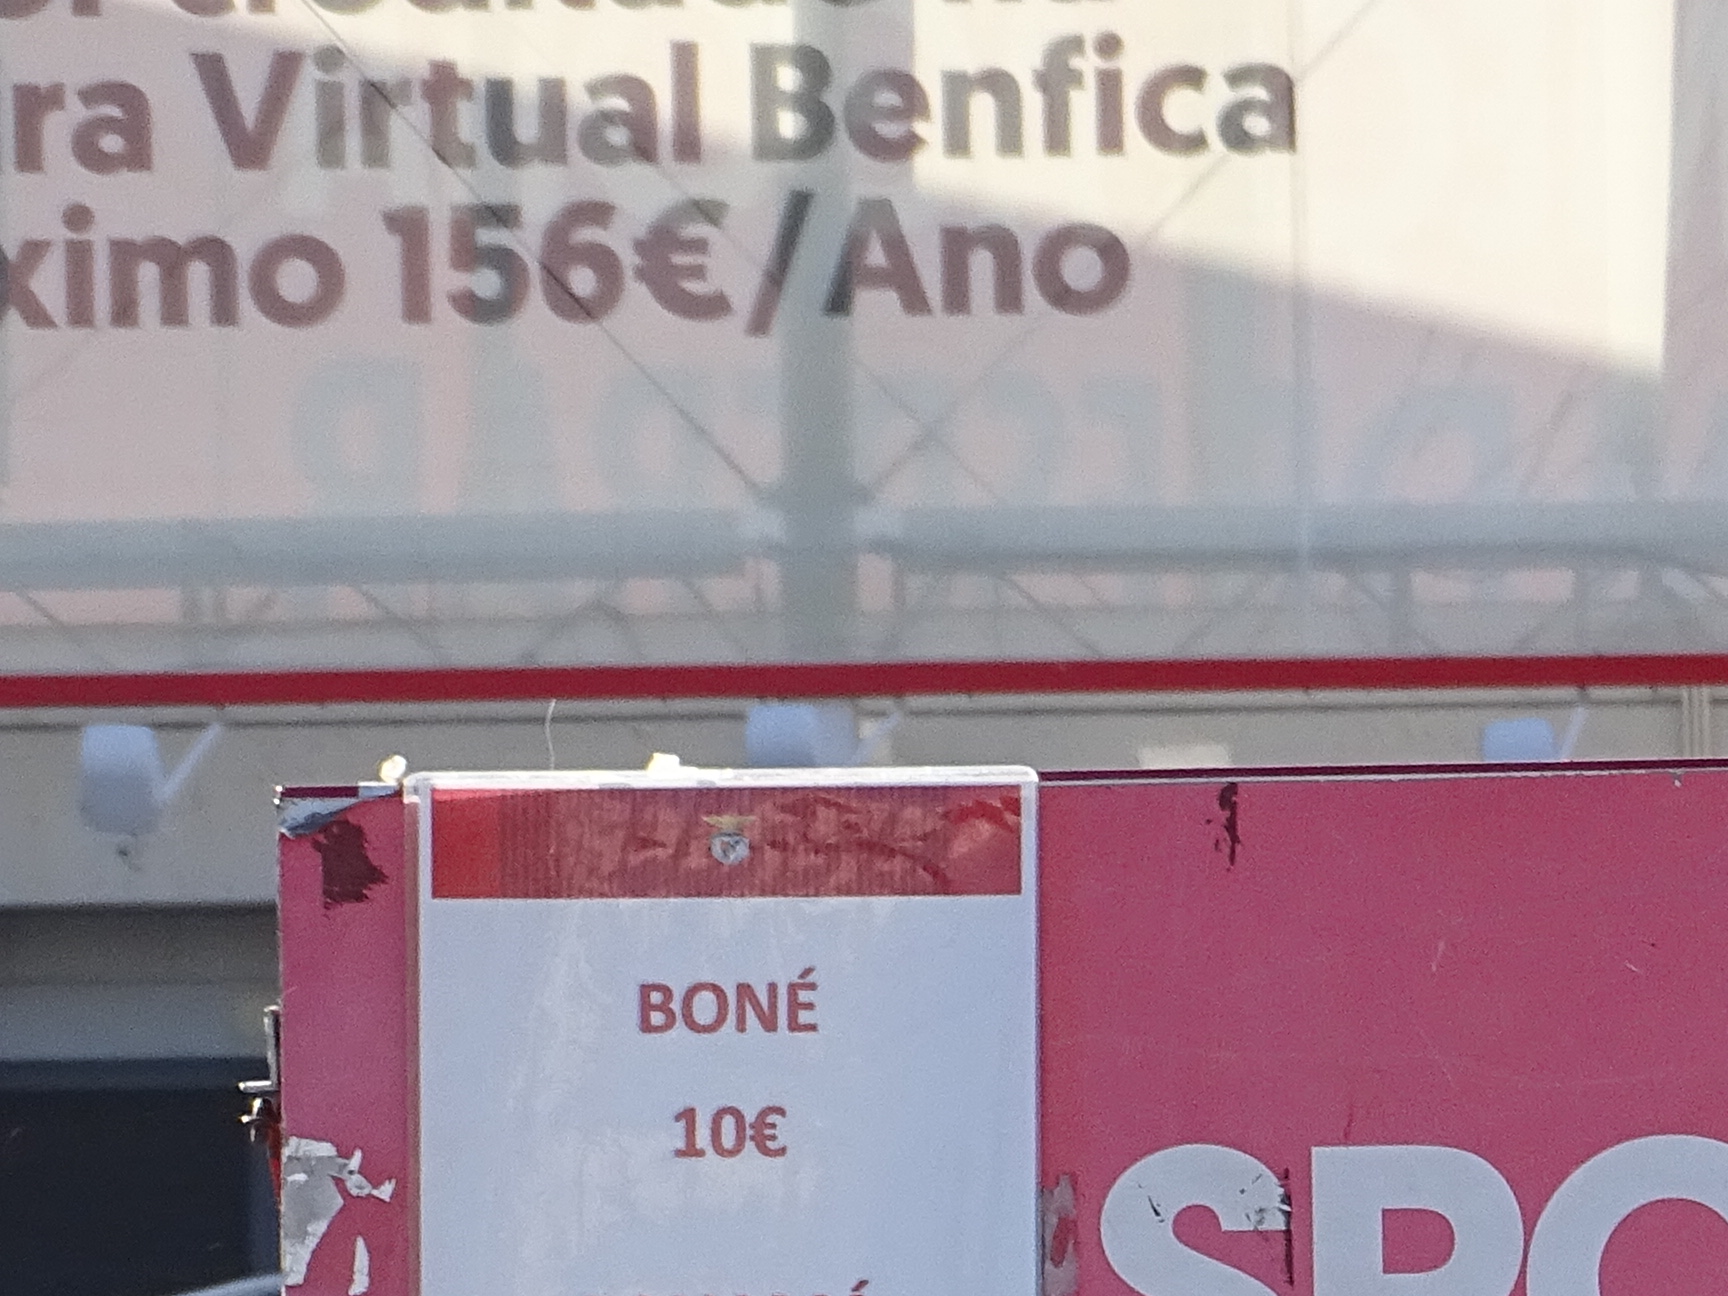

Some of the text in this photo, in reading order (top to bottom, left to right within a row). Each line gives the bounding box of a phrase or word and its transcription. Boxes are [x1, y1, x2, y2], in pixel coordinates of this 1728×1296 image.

[192, 42, 703, 172] Virtual
[750, 35, 1298, 162] Benfica
[383, 192, 1132, 337] 156€/Ano
[637, 968, 819, 1034] BONÉ
[672, 1105, 788, 1159] 10€
